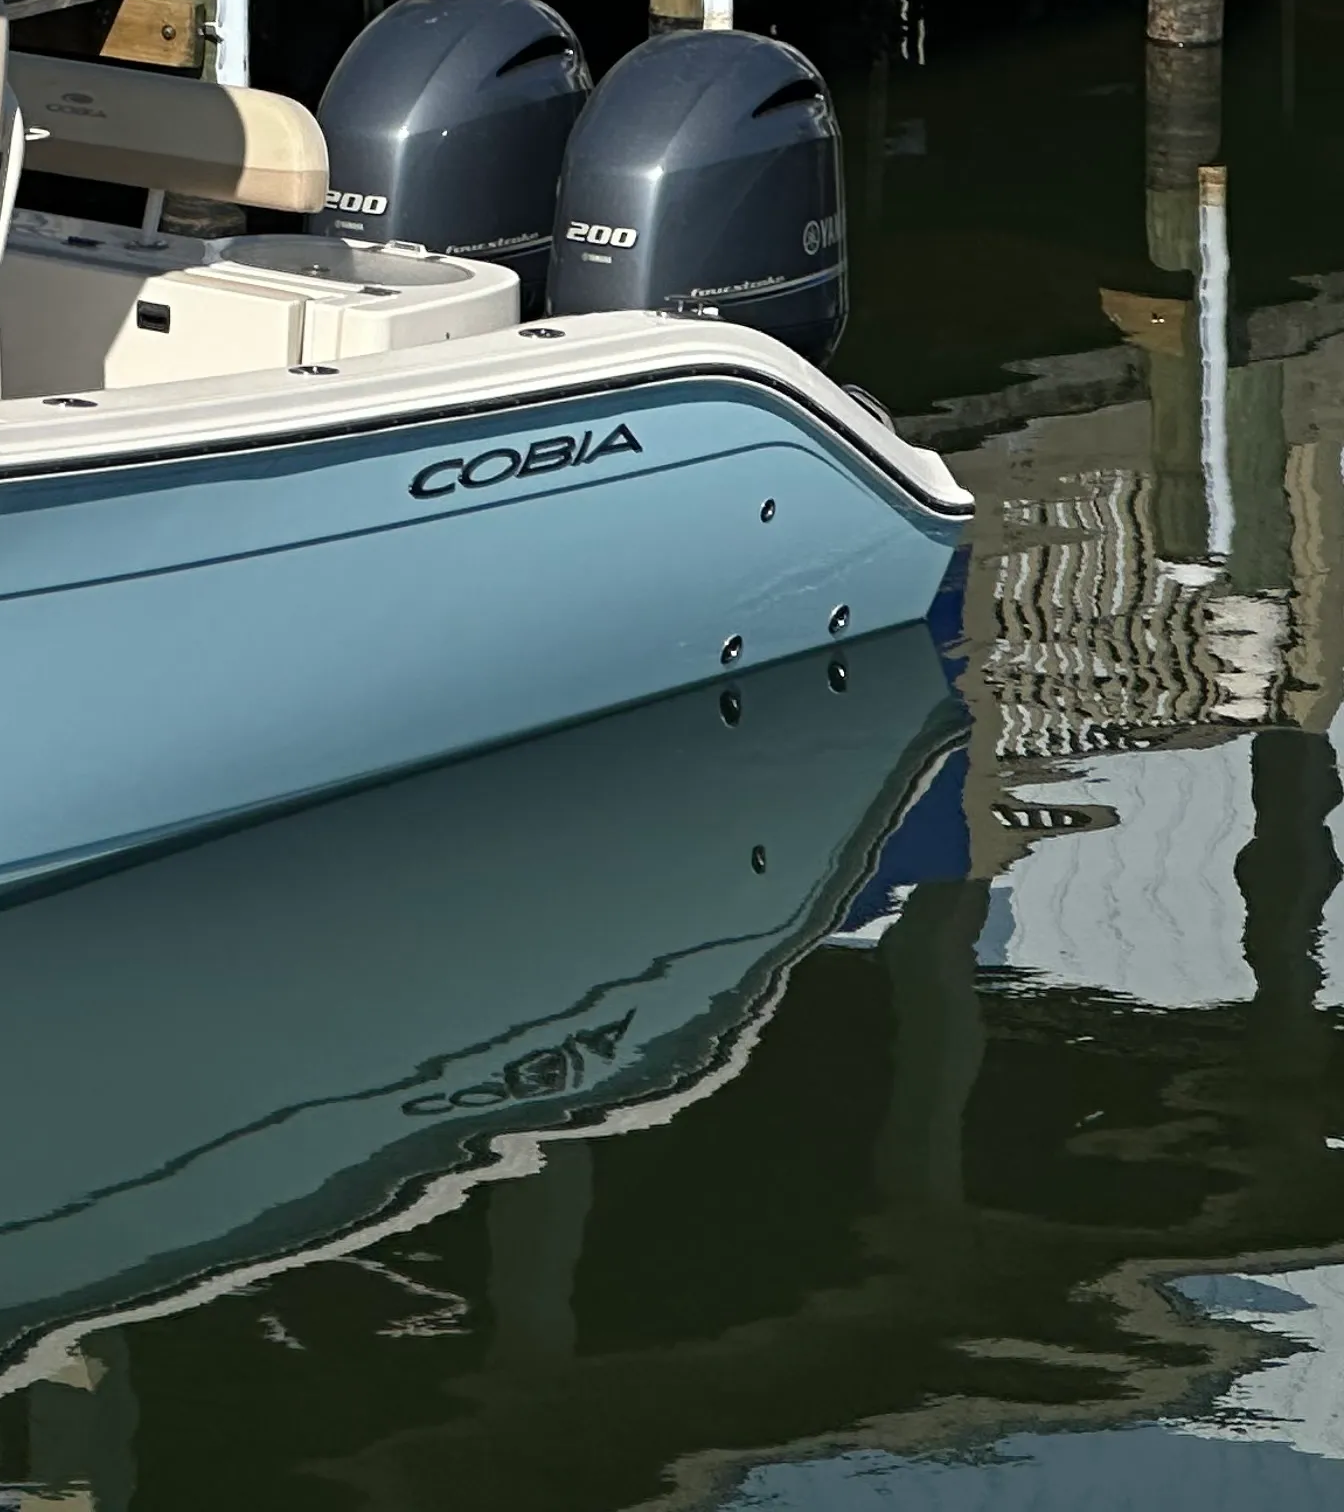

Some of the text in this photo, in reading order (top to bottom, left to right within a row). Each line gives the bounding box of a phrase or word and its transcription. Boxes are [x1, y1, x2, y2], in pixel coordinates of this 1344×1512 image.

[323, 189, 389, 216] 200
[566, 220, 638, 249] 200
[407, 422, 644, 500] COBIA
